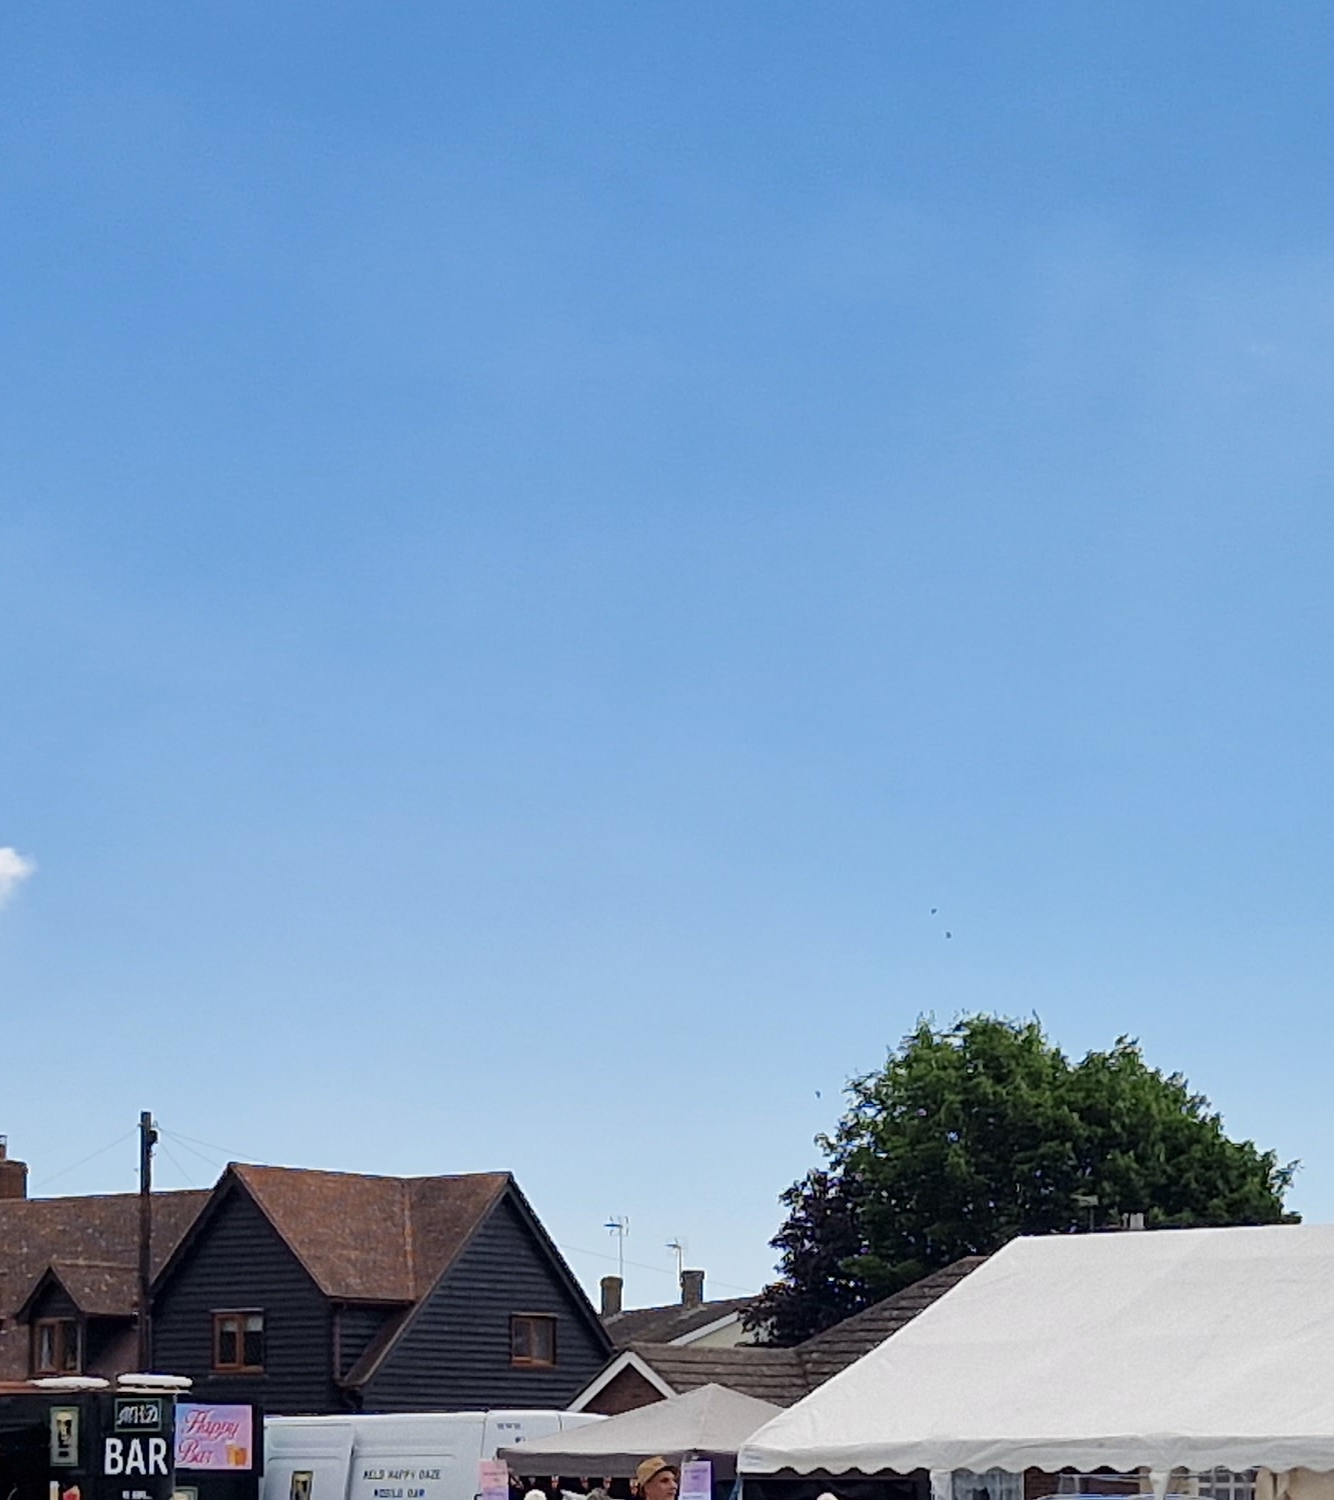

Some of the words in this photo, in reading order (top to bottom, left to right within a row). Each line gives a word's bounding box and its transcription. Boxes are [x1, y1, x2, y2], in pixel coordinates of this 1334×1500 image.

[183, 1409, 240, 1440] Happy
[104, 1437, 168, 1475] BAR
[178, 1438, 213, 1465] Bar
